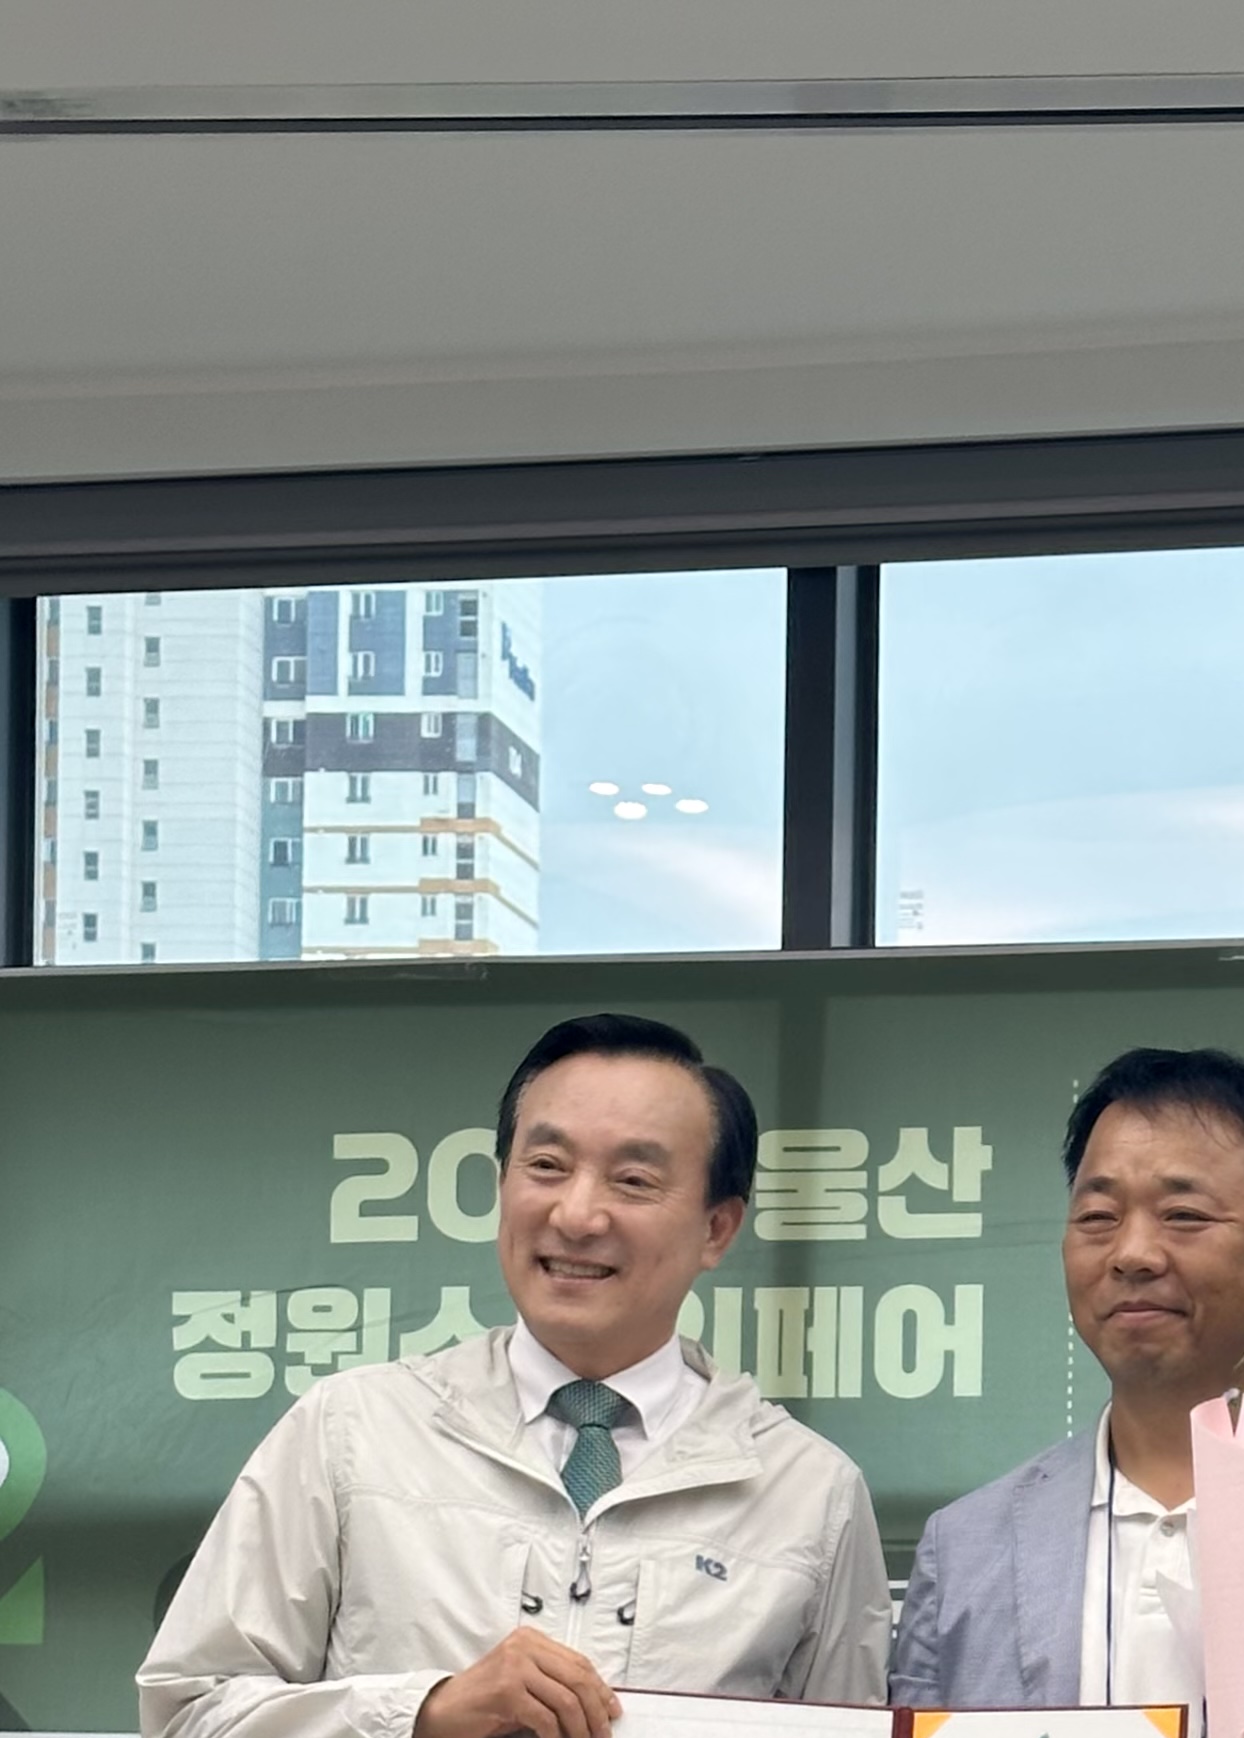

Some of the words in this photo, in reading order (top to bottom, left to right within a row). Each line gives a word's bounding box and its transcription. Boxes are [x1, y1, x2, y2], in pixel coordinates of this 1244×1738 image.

[330, 1128, 501, 1244] 20
[753, 1126, 993, 1242] 울산
[172, 1284, 984, 1402] 정원페어
[695, 1555, 728, 1582] K2
